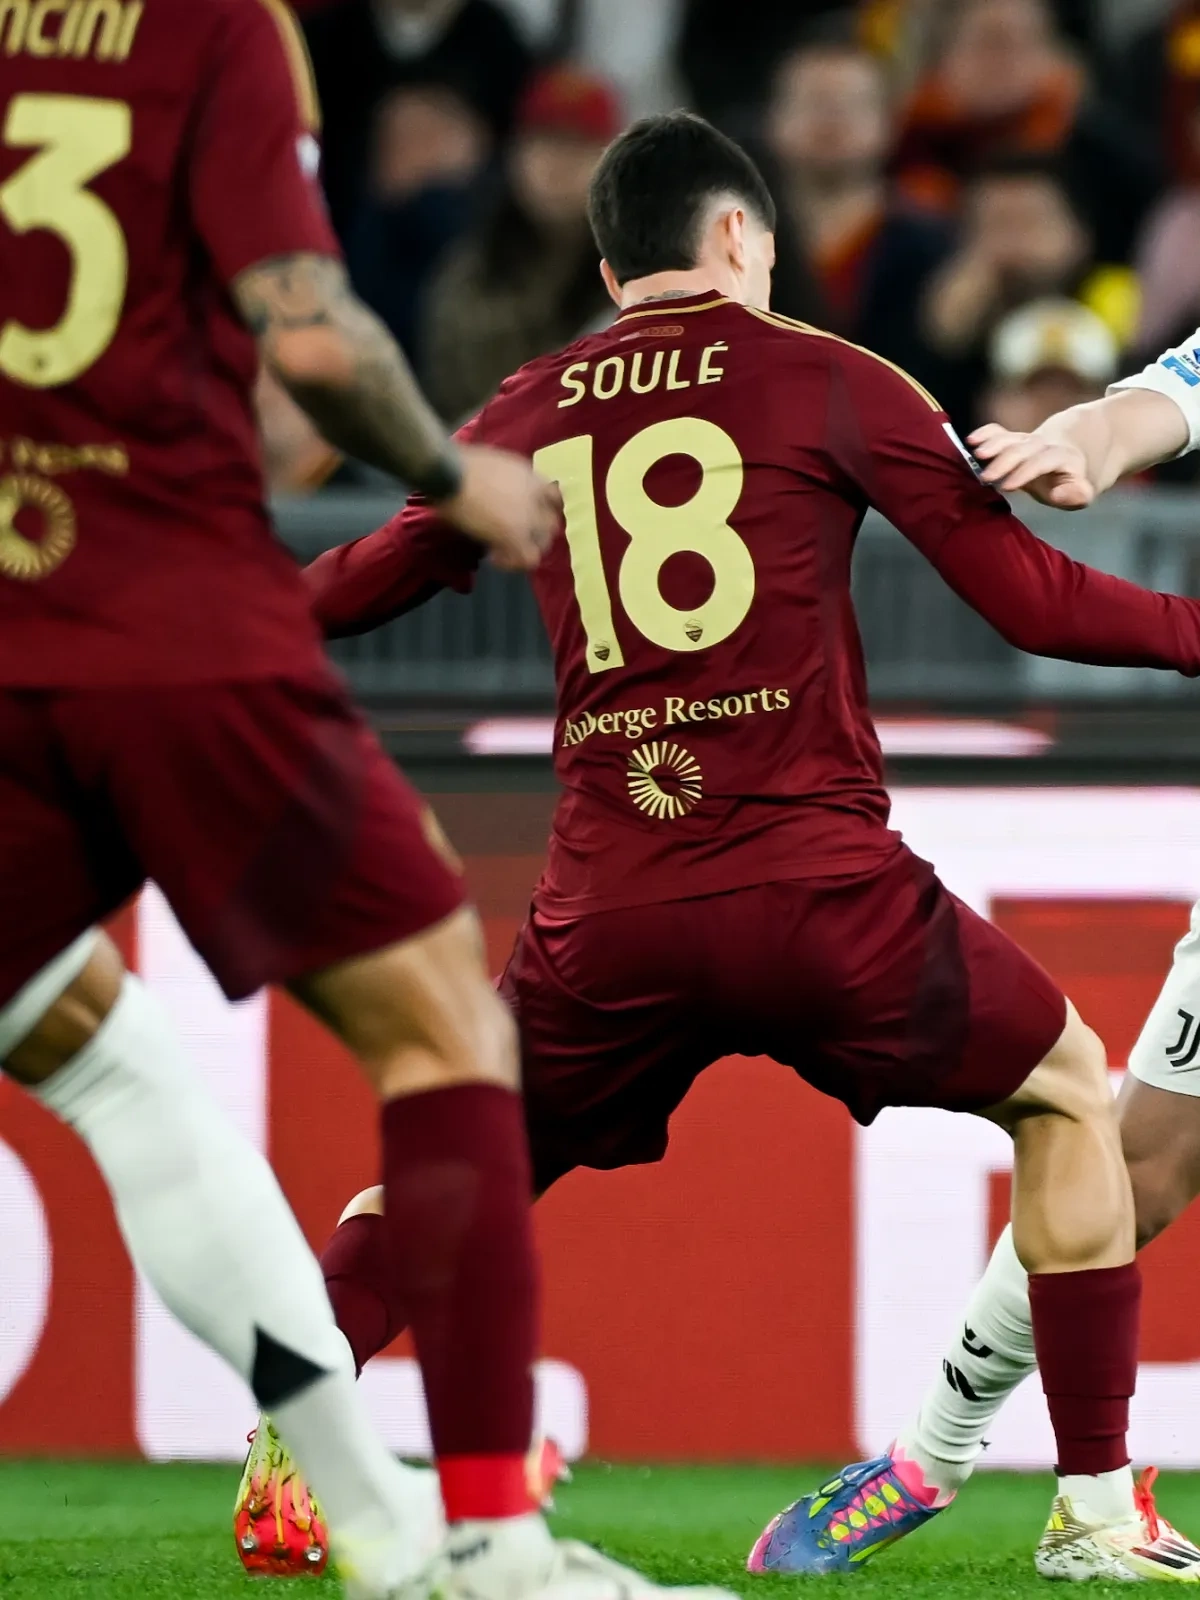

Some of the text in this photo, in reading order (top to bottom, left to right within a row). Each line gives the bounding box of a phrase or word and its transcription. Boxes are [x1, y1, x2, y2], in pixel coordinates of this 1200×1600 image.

[0, 93, 132, 389] 3
[557, 340, 729, 409] SOULÉ
[533, 416, 756, 674] 18
[562, 687, 791, 747] Auberge Resorts
